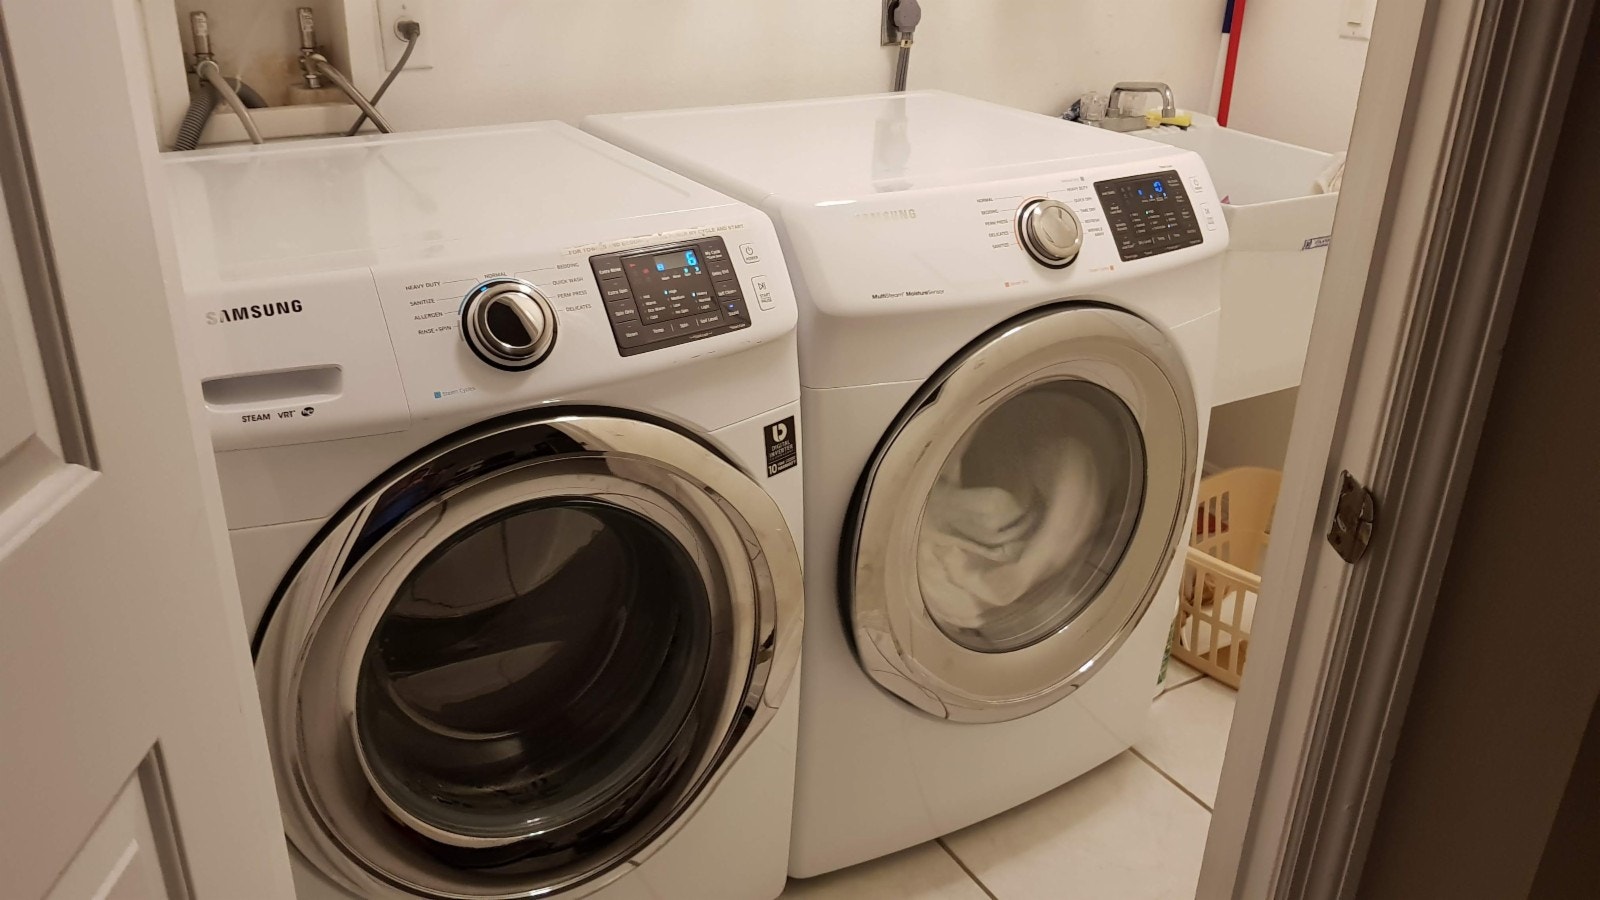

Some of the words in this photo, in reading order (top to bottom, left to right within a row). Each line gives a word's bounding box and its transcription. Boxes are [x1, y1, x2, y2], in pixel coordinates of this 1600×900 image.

[557, 262, 580, 270] BEDDING
[484, 271, 508, 279] NORMAL
[405, 283, 424, 291] HEAVY
[409, 297, 436, 307] SANITIZE
[205, 299, 303, 325] SAMSUNG
[565, 303, 592, 312] DELICATES
[414, 311, 443, 321] ALLERGEN
[242, 412, 271, 423] STEAM
[769, 443, 794, 458] INVERTER
[771, 439, 791, 452] DIGITAL
[768, 463, 778, 475] 10
